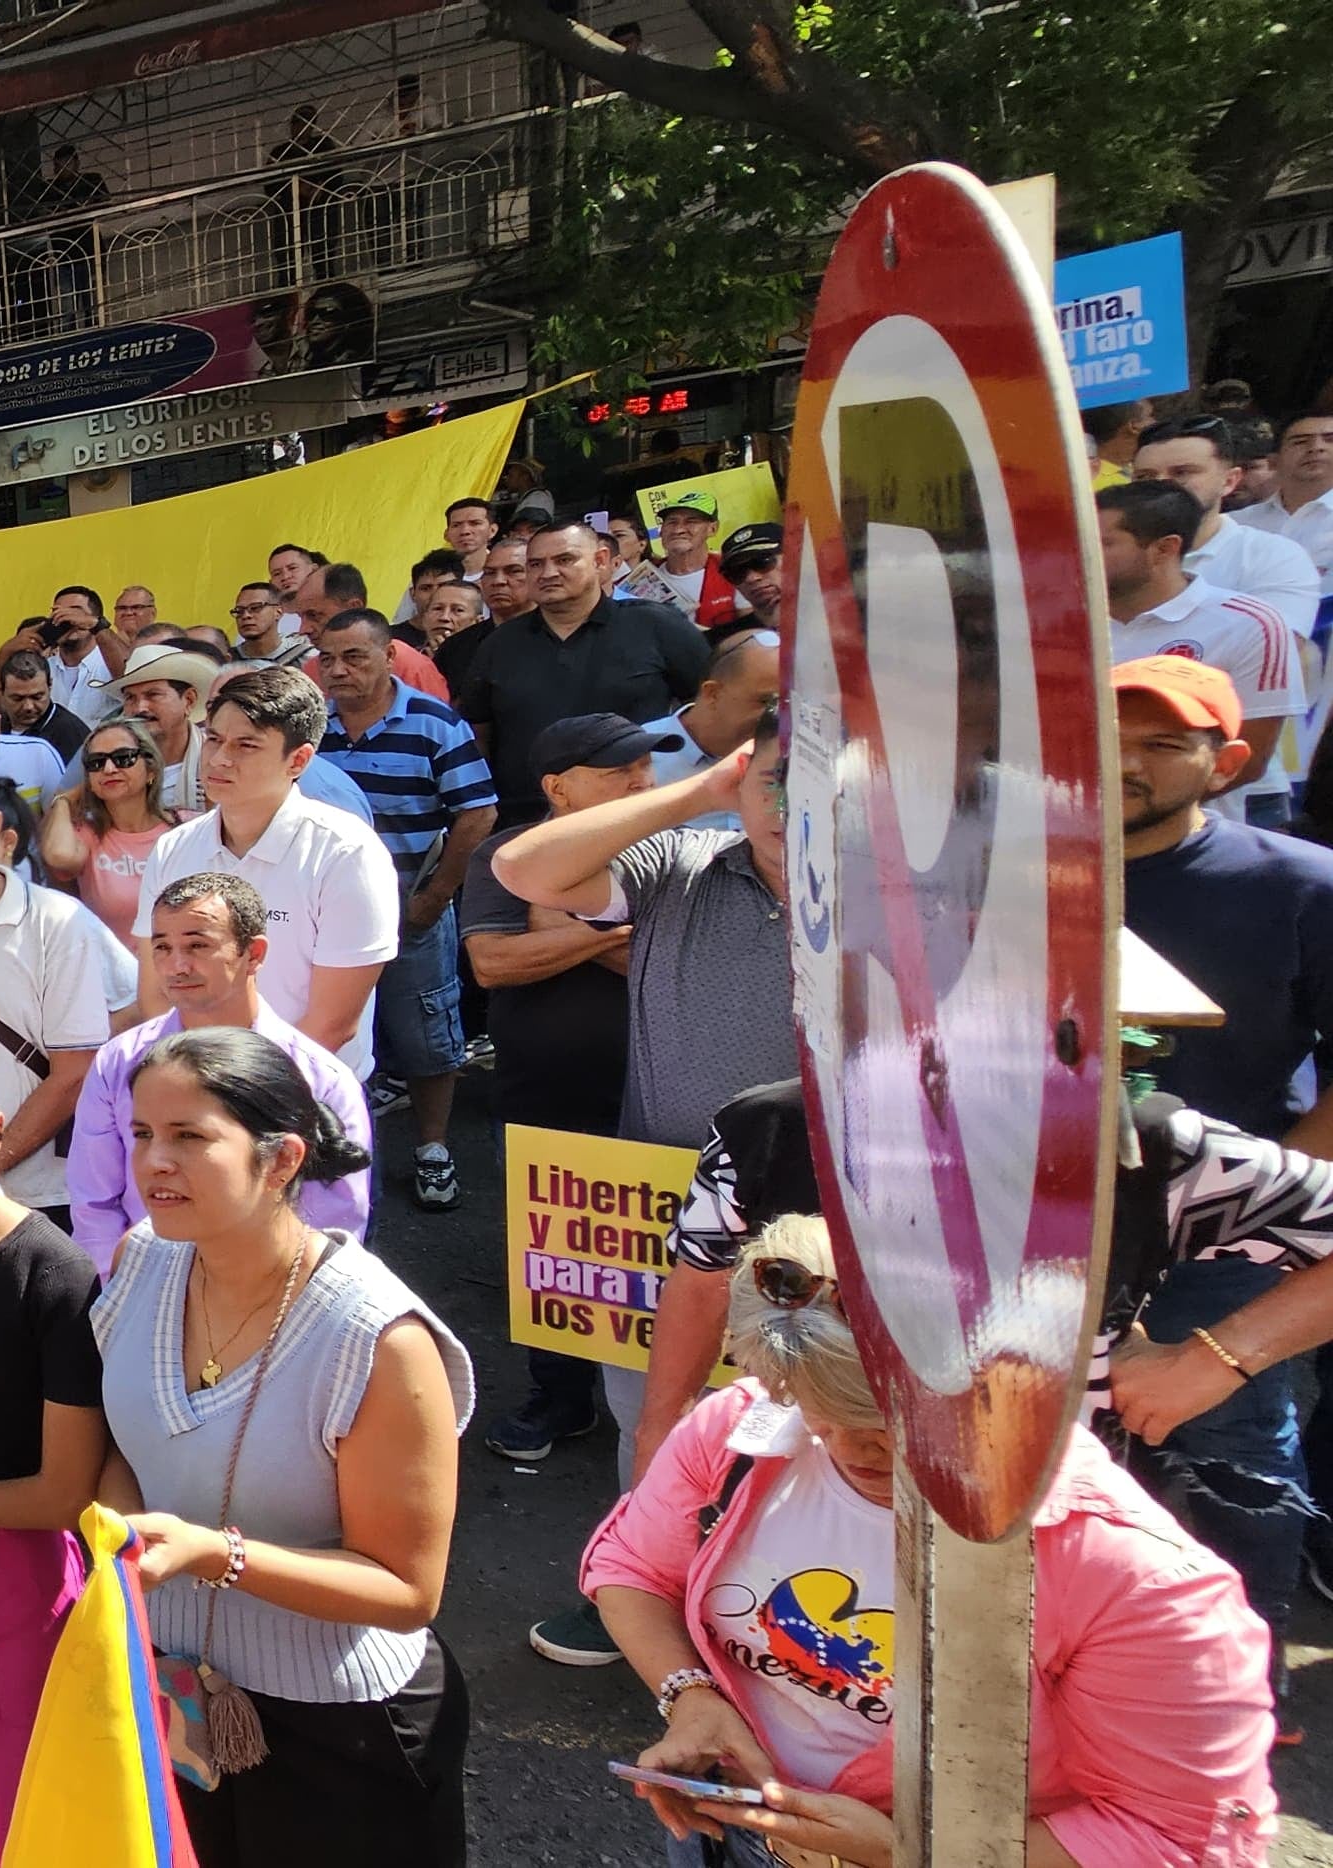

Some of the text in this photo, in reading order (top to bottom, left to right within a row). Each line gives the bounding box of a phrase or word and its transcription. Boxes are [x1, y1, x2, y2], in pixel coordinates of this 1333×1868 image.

[1055, 295, 1134, 332] rina,
[38, 354, 62, 377] DE
[68, 349, 102, 371] LOS
[109, 333, 179, 363] LENTES
[1087, 320, 1153, 357] faro
[1070, 353, 1151, 388] anza.
[88, 384, 254, 436] EL SURTIDOR
[73, 411, 275, 467] DE LOS LENTES
[528, 1163, 681, 1226] Liberta
[528, 1211, 552, 1250] y
[528, 1252, 628, 1304] para
[531, 1289, 654, 1350] los ve
